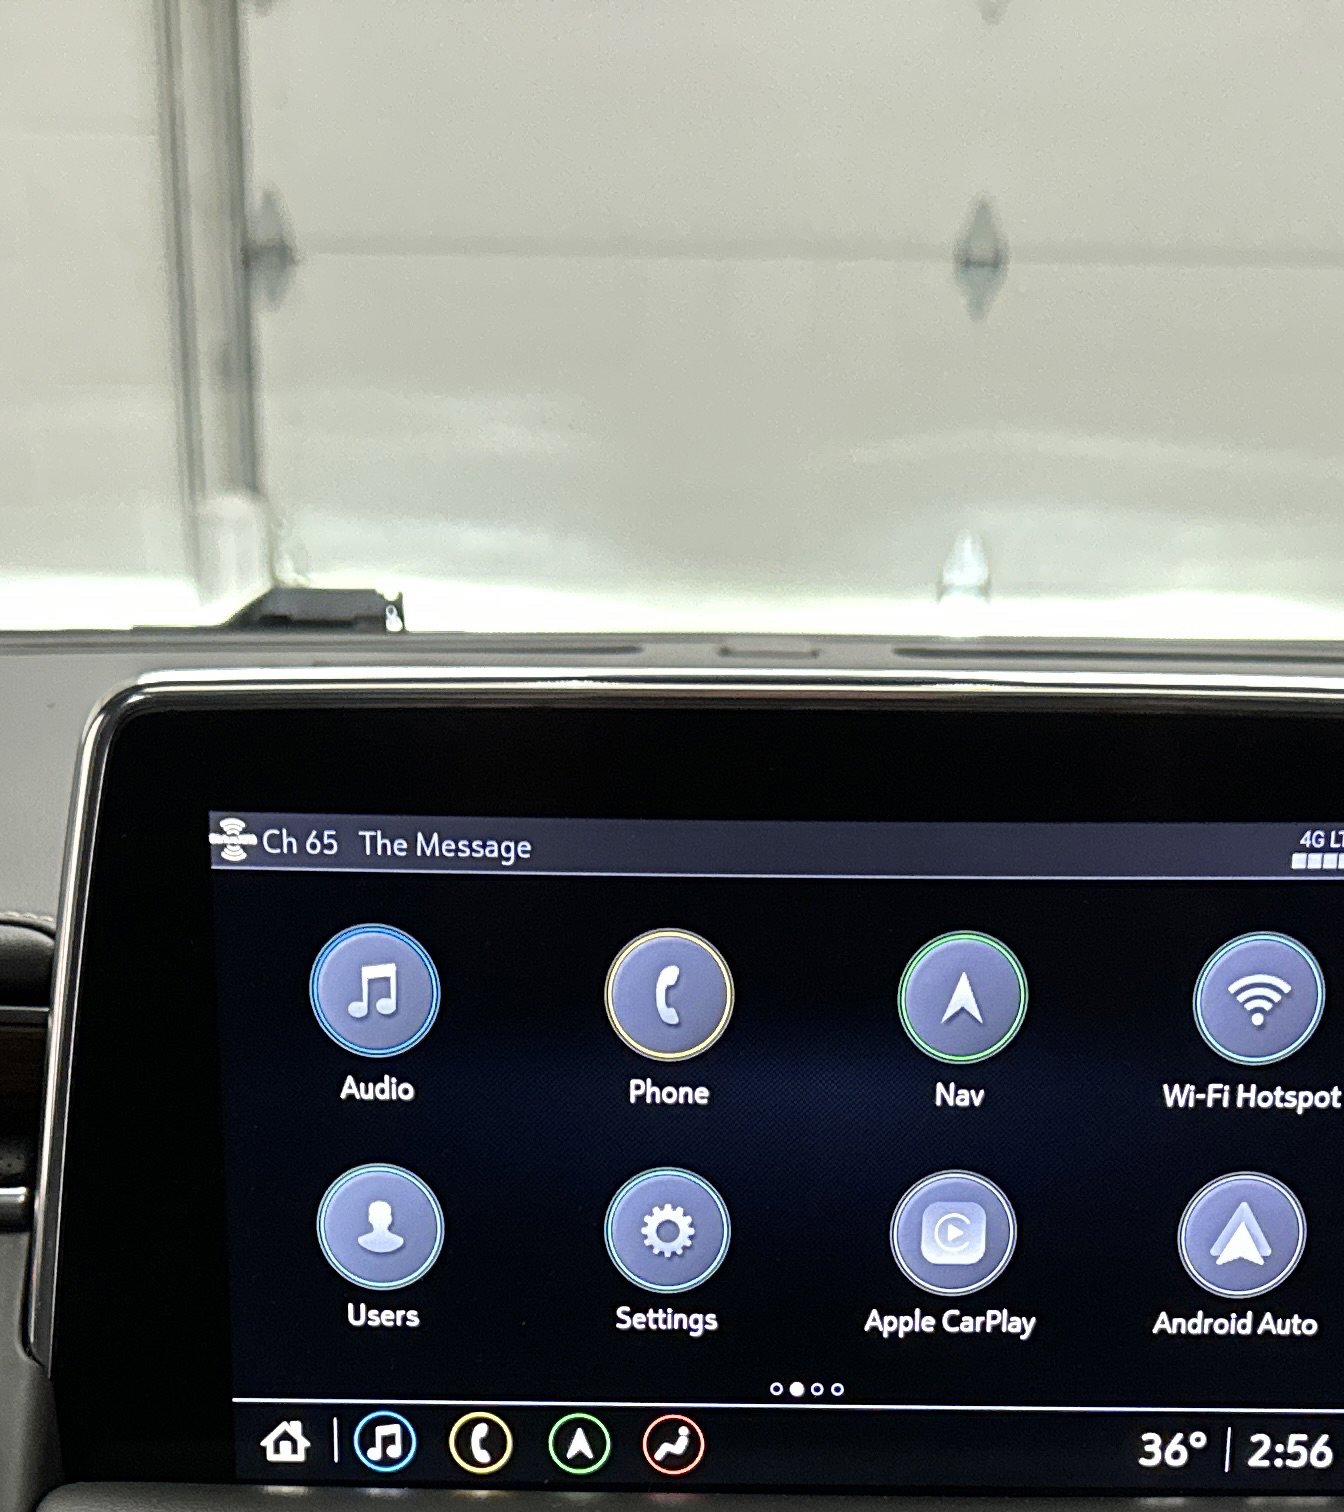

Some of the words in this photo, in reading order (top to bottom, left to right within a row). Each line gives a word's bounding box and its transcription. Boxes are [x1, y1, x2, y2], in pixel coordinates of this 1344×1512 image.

[262, 827, 298, 854] Ch
[305, 829, 338, 855] 65
[358, 829, 408, 857] The
[416, 831, 532, 866] Message
[1299, 829, 1326, 849] 4G
[339, 1074, 415, 1101] Audio
[629, 1077, 710, 1105] Phone
[935, 1081, 985, 1107] Nav
[1162, 1083, 1230, 1108] Wi-Fi
[1236, 1083, 1343, 1115] Hotspot
[347, 1302, 421, 1327] Users
[615, 1305, 719, 1338] Settings
[863, 1307, 936, 1339] Apple
[941, 1307, 1037, 1341] CarPlay
[1151, 1309, 1253, 1335] Android
[1256, 1311, 1319, 1336] Auto
[1138, 1430, 1208, 1467] 36°
[1247, 1433, 1334, 1469] 2:56
